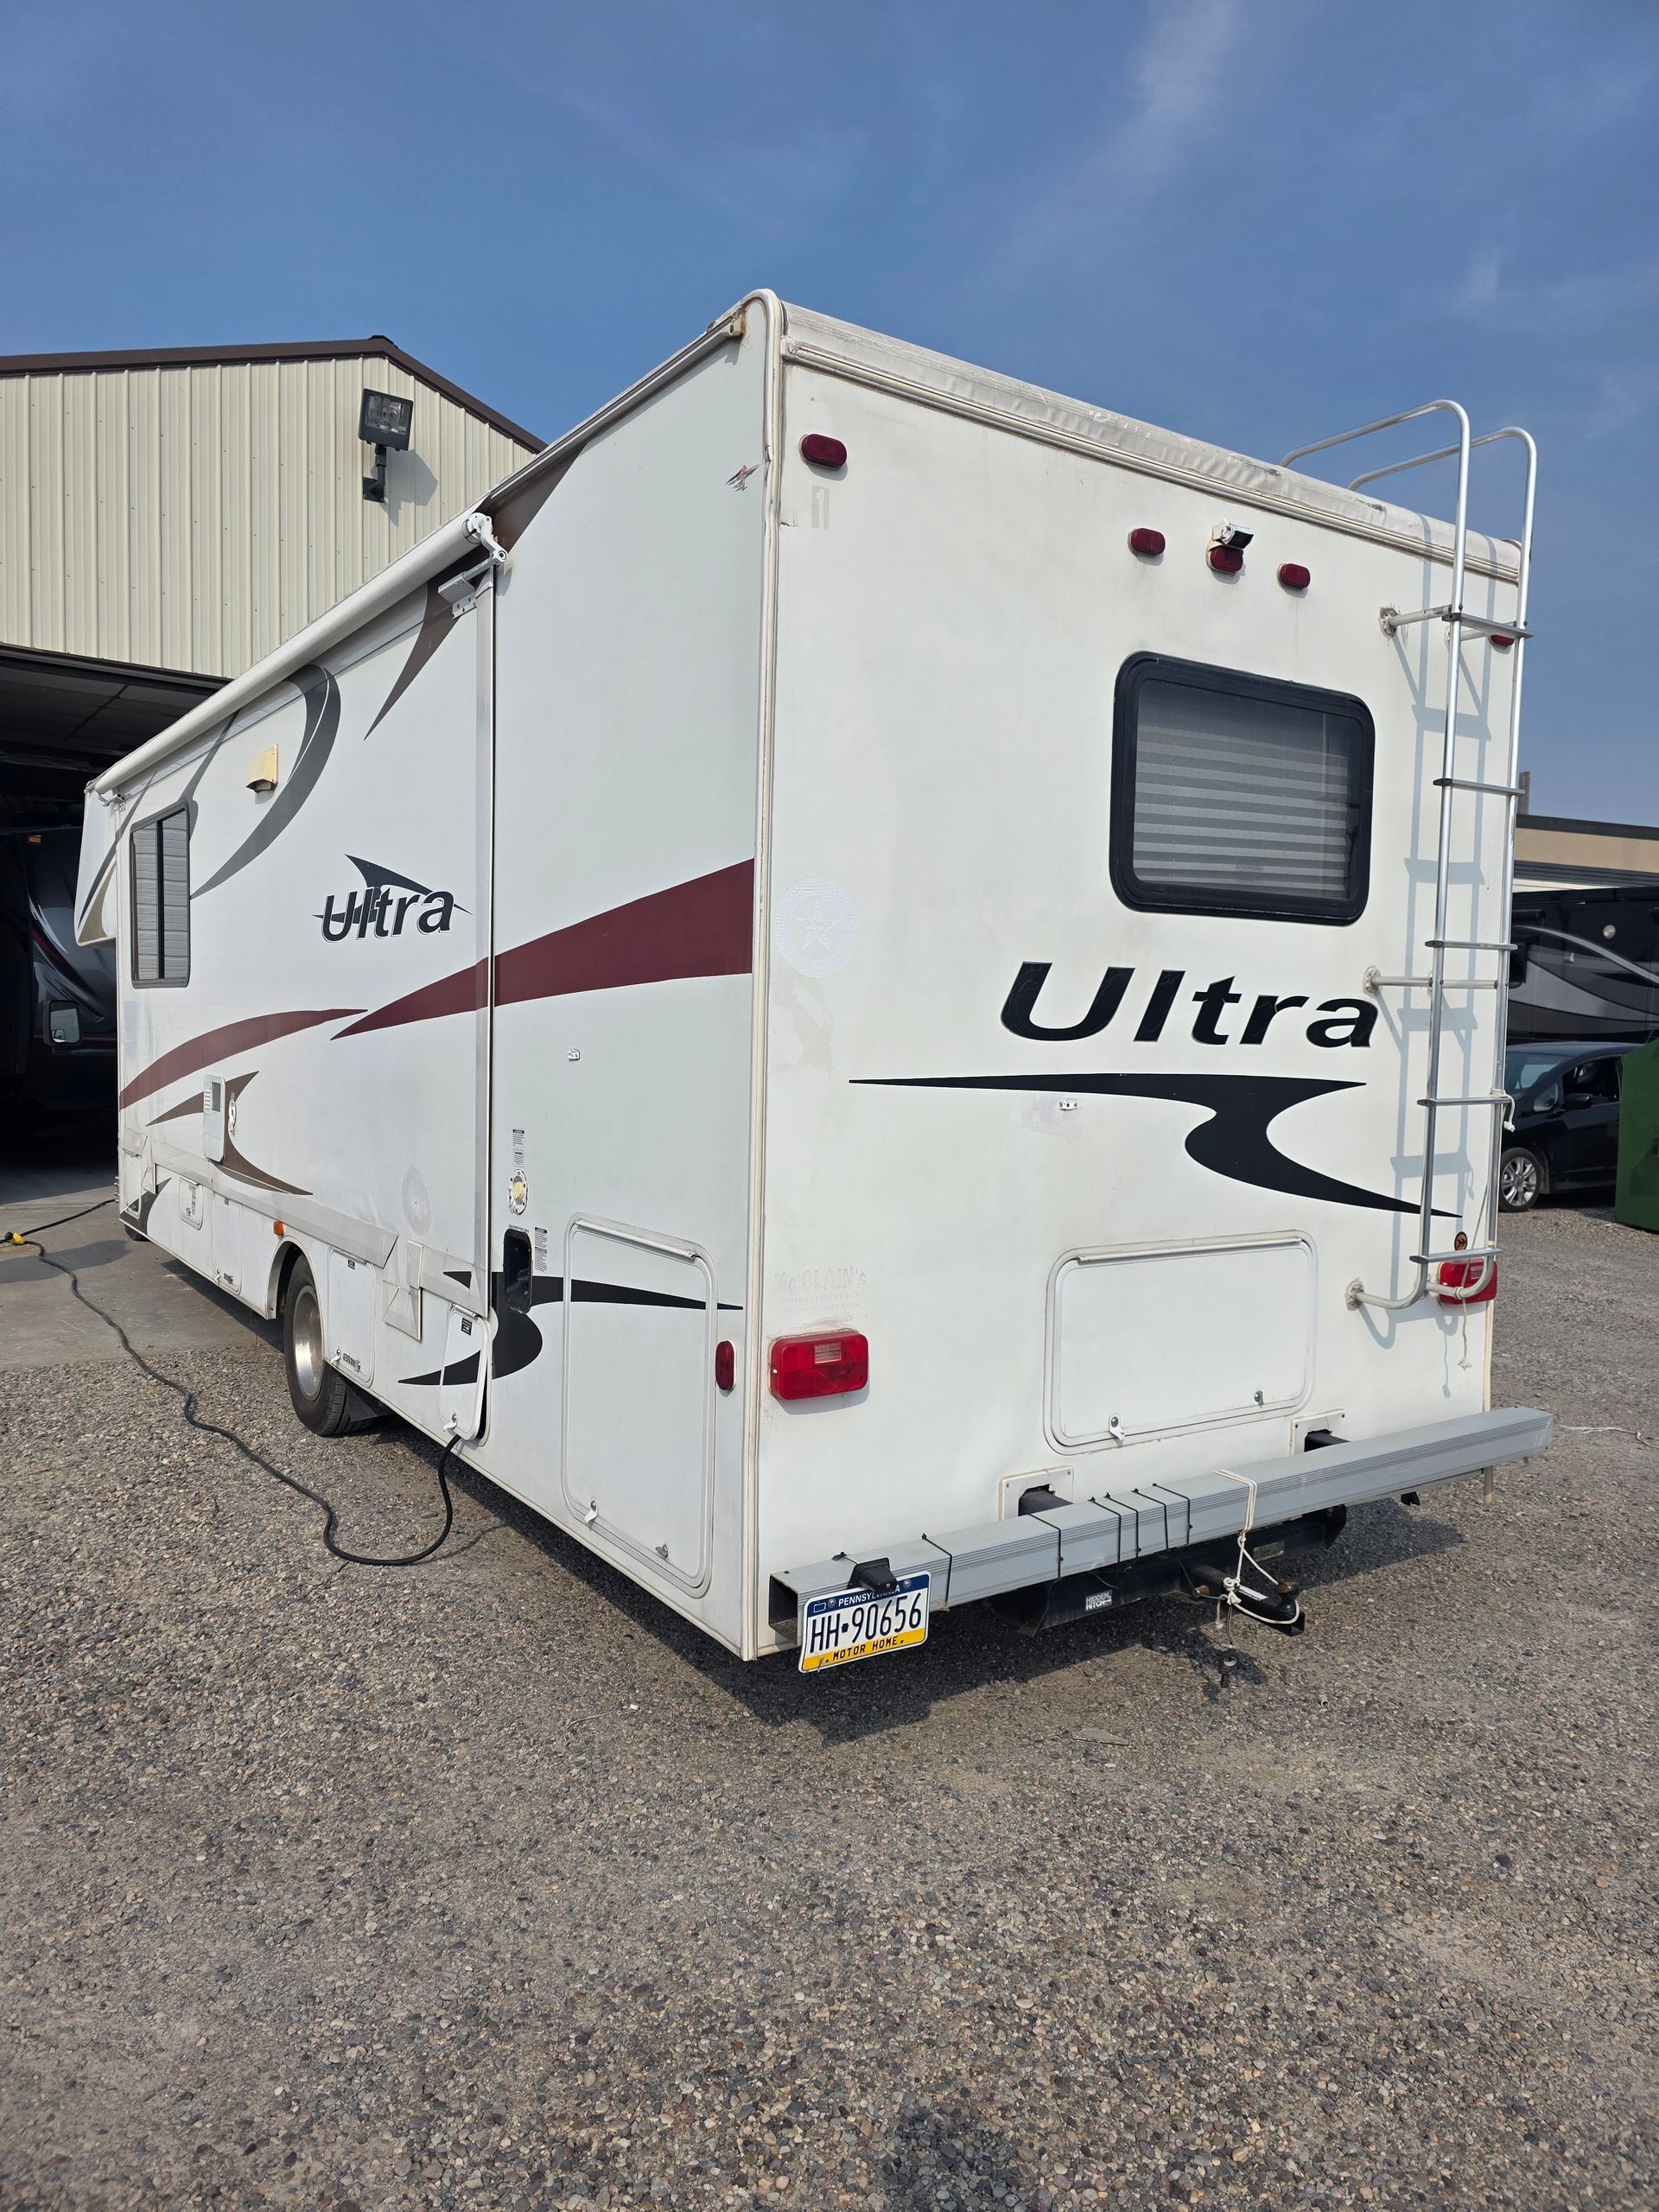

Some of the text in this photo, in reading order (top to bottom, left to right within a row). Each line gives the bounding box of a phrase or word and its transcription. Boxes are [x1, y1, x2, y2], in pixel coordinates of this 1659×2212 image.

[321, 887, 454, 944] Ultra
[1000, 961, 1379, 1049] Ultra
[837, 1585, 900, 1607] PENNSYLA
[832, 1636, 899, 1661] MOTOR HOME
